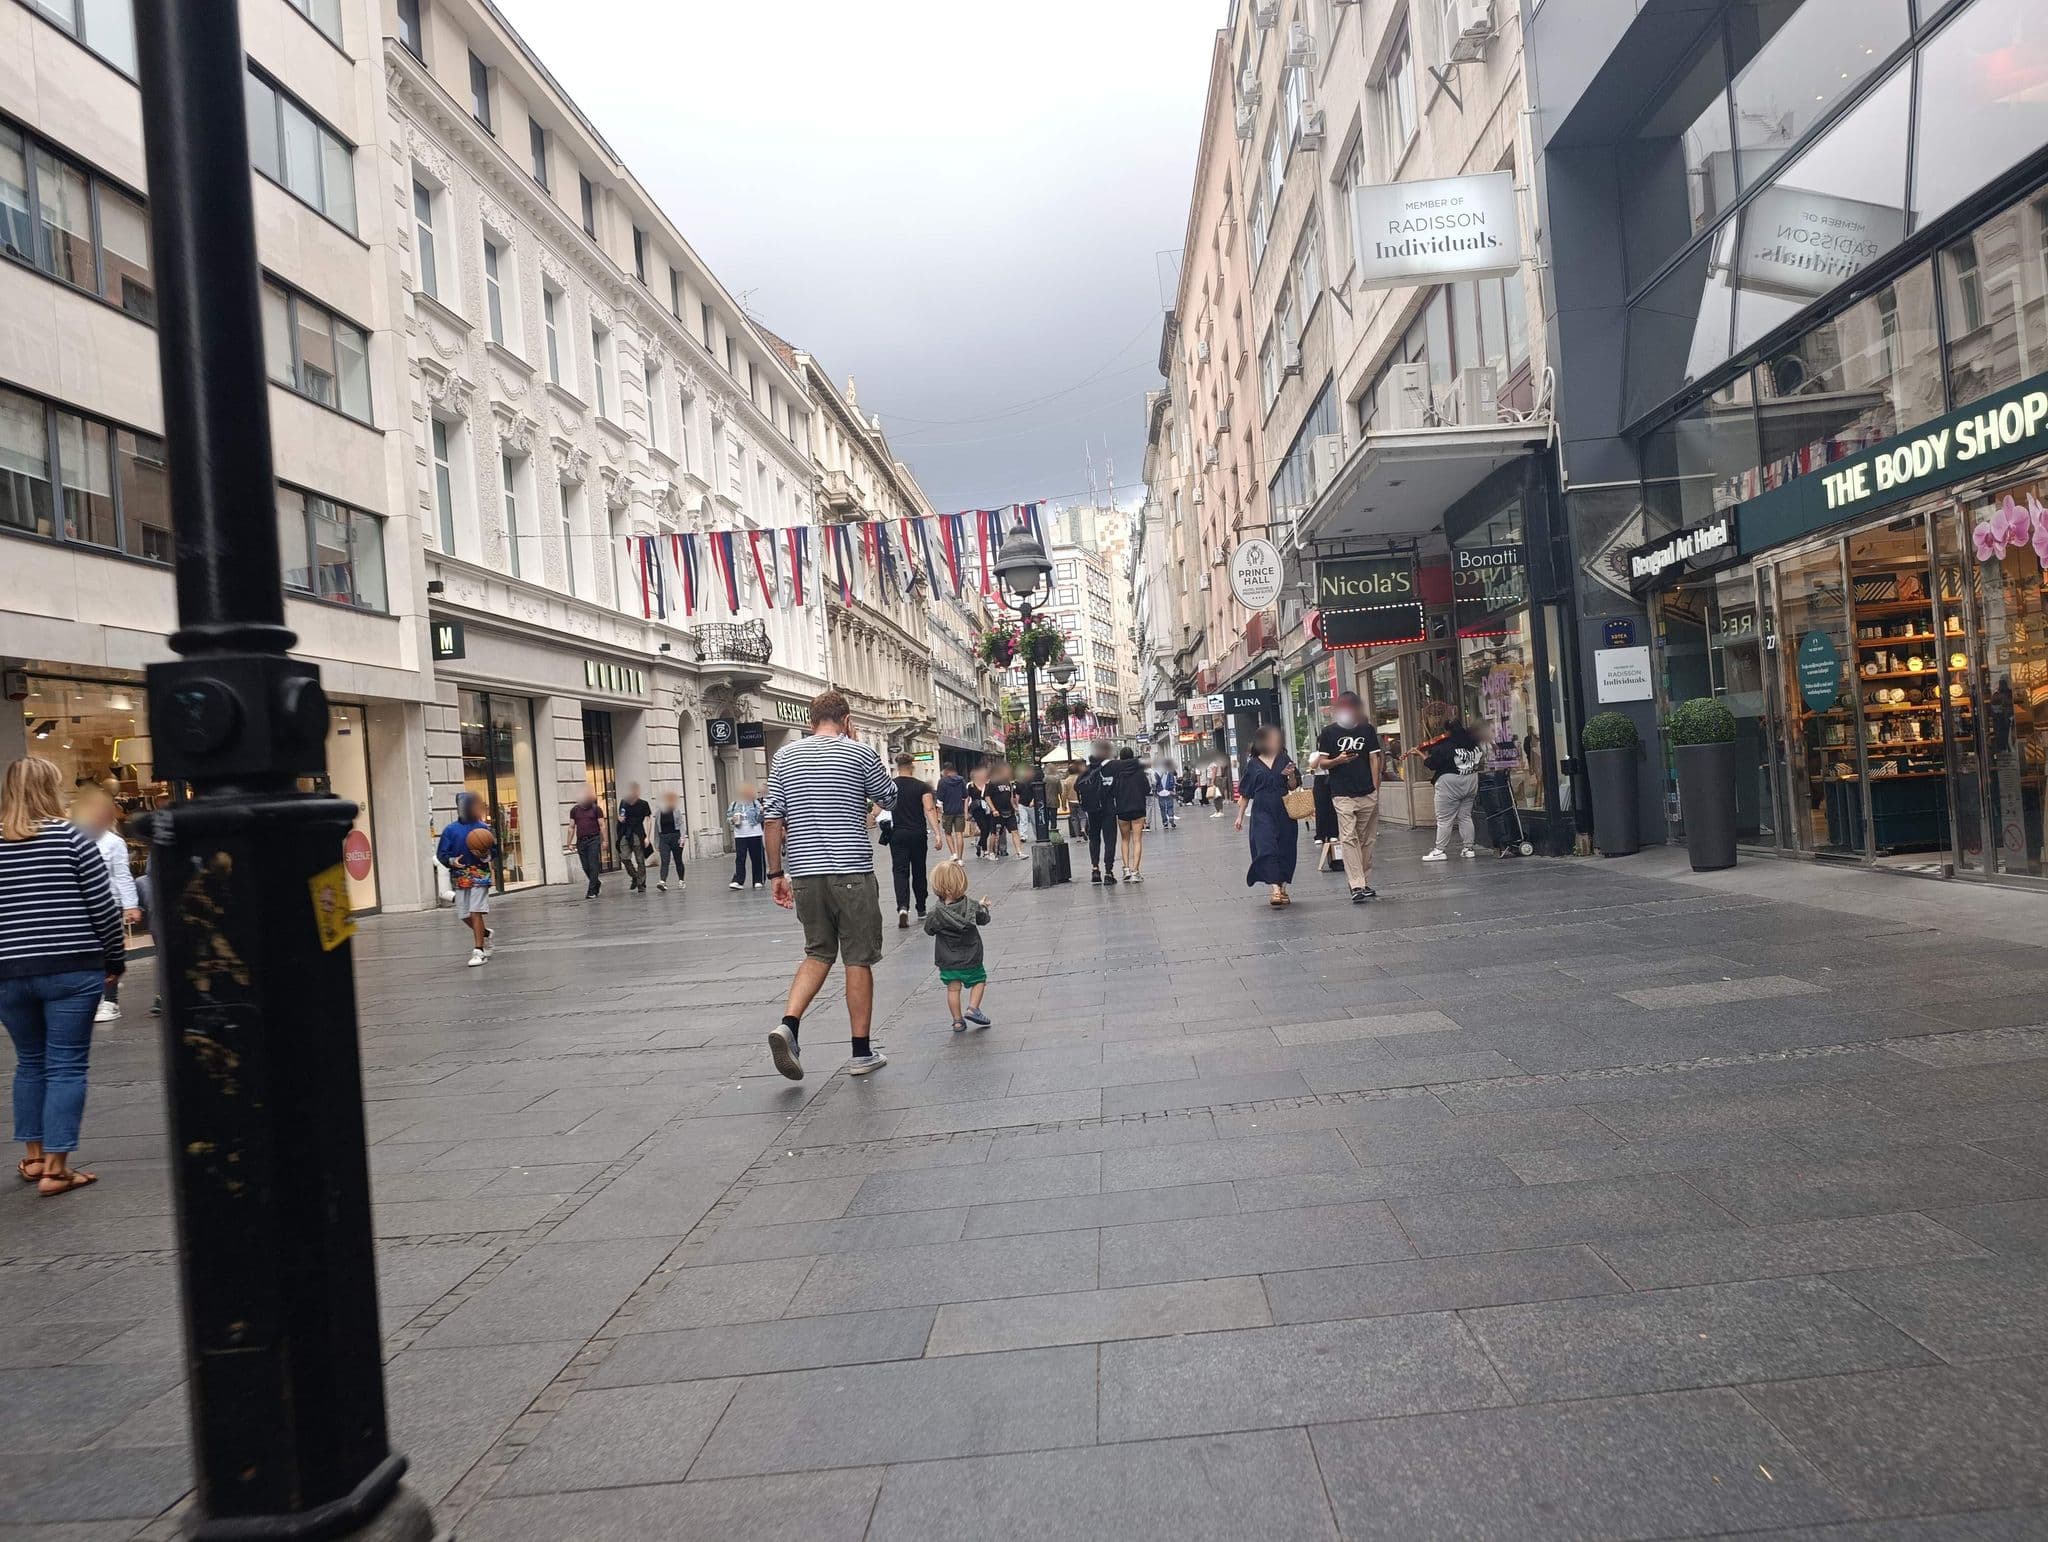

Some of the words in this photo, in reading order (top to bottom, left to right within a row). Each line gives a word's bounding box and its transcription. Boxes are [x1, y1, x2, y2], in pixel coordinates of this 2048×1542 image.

[1405, 199, 1448, 210] MEMBER
[1450, 197, 1464, 206] OF
[1388, 211, 1485, 234] RADISSON
[1375, 231, 1503, 259] Individuals.
[1821, 462, 1871, 509] THE
[1875, 428, 1950, 492] BODY
[1460, 548, 1517, 568] Bonatti
[1631, 541, 1676, 578] Beograd
[1676, 535, 1695, 560] Art
[1694, 519, 1728, 554] Hotel
[1238, 567, 1275, 578] PRINCE
[1244, 576, 1270, 585] HALL
[440, 627, 453, 649] M
[1608, 670, 1642, 678] RADISSON
[776, 701, 812, 722] RESERVE
[1234, 698, 1261, 707] LUNA
